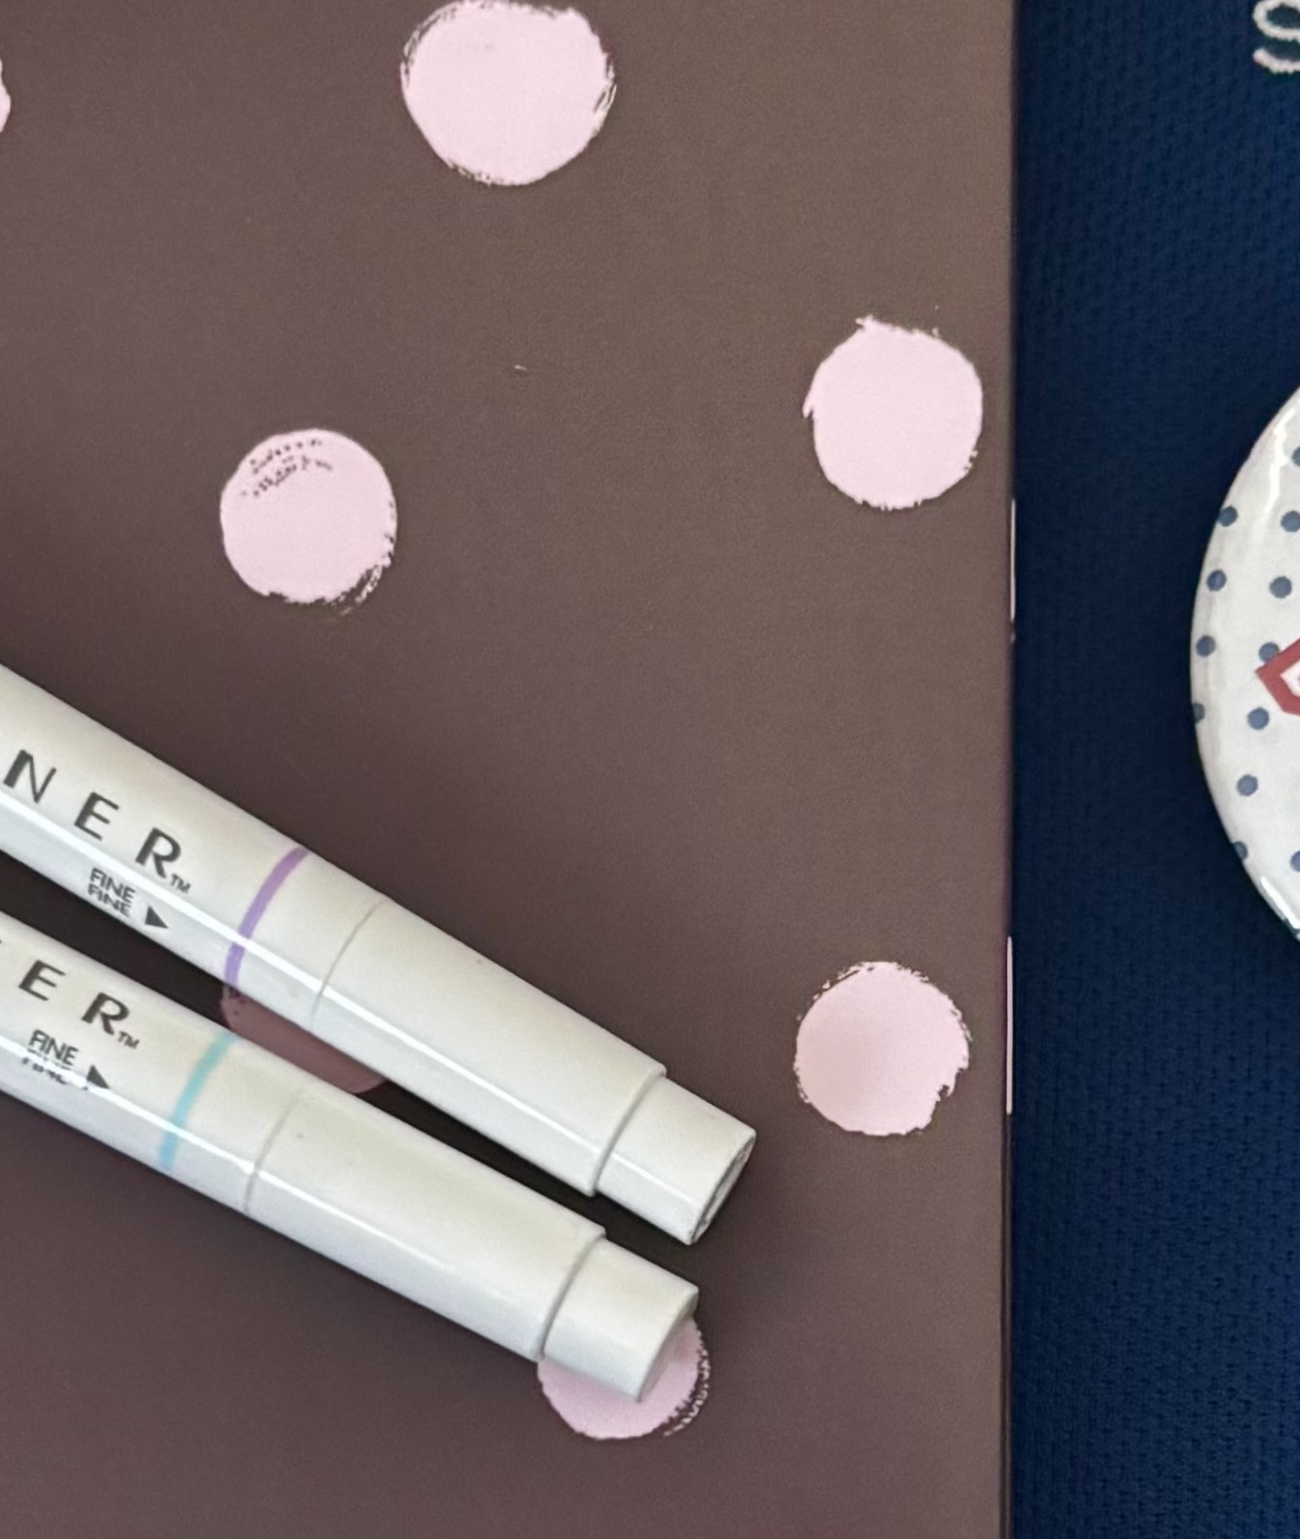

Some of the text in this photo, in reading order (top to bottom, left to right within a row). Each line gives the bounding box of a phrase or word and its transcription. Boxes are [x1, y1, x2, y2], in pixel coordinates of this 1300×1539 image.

[88, 883, 131, 917] FINE
[90, 867, 136, 905] FINE
[28, 1029, 79, 1067] FINE
